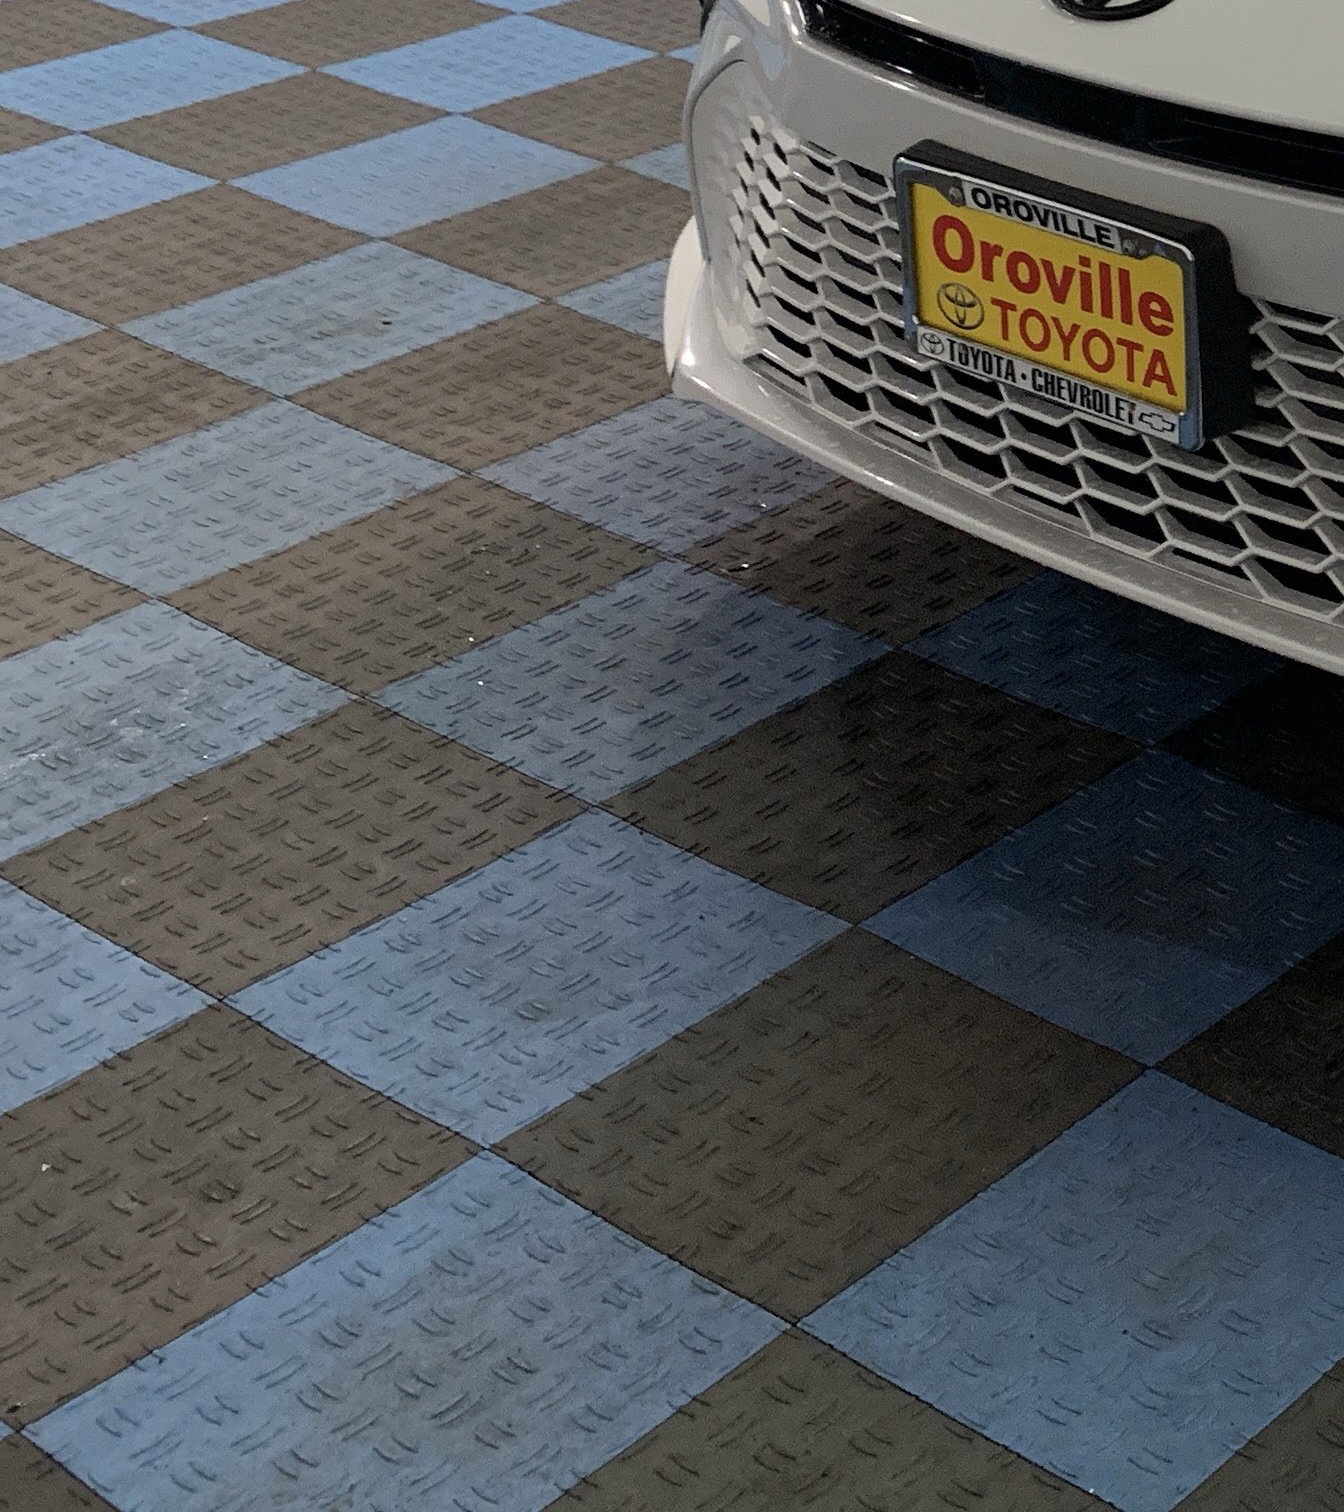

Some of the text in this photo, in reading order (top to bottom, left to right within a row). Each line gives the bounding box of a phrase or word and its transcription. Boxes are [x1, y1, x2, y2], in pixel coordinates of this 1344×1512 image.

[971, 187, 1116, 249] OROVILLE
[932, 215, 1175, 337] Oroville
[946, 338, 1138, 426] TOYOTA CHEVROLET
[990, 297, 1178, 397] TOYOTA
